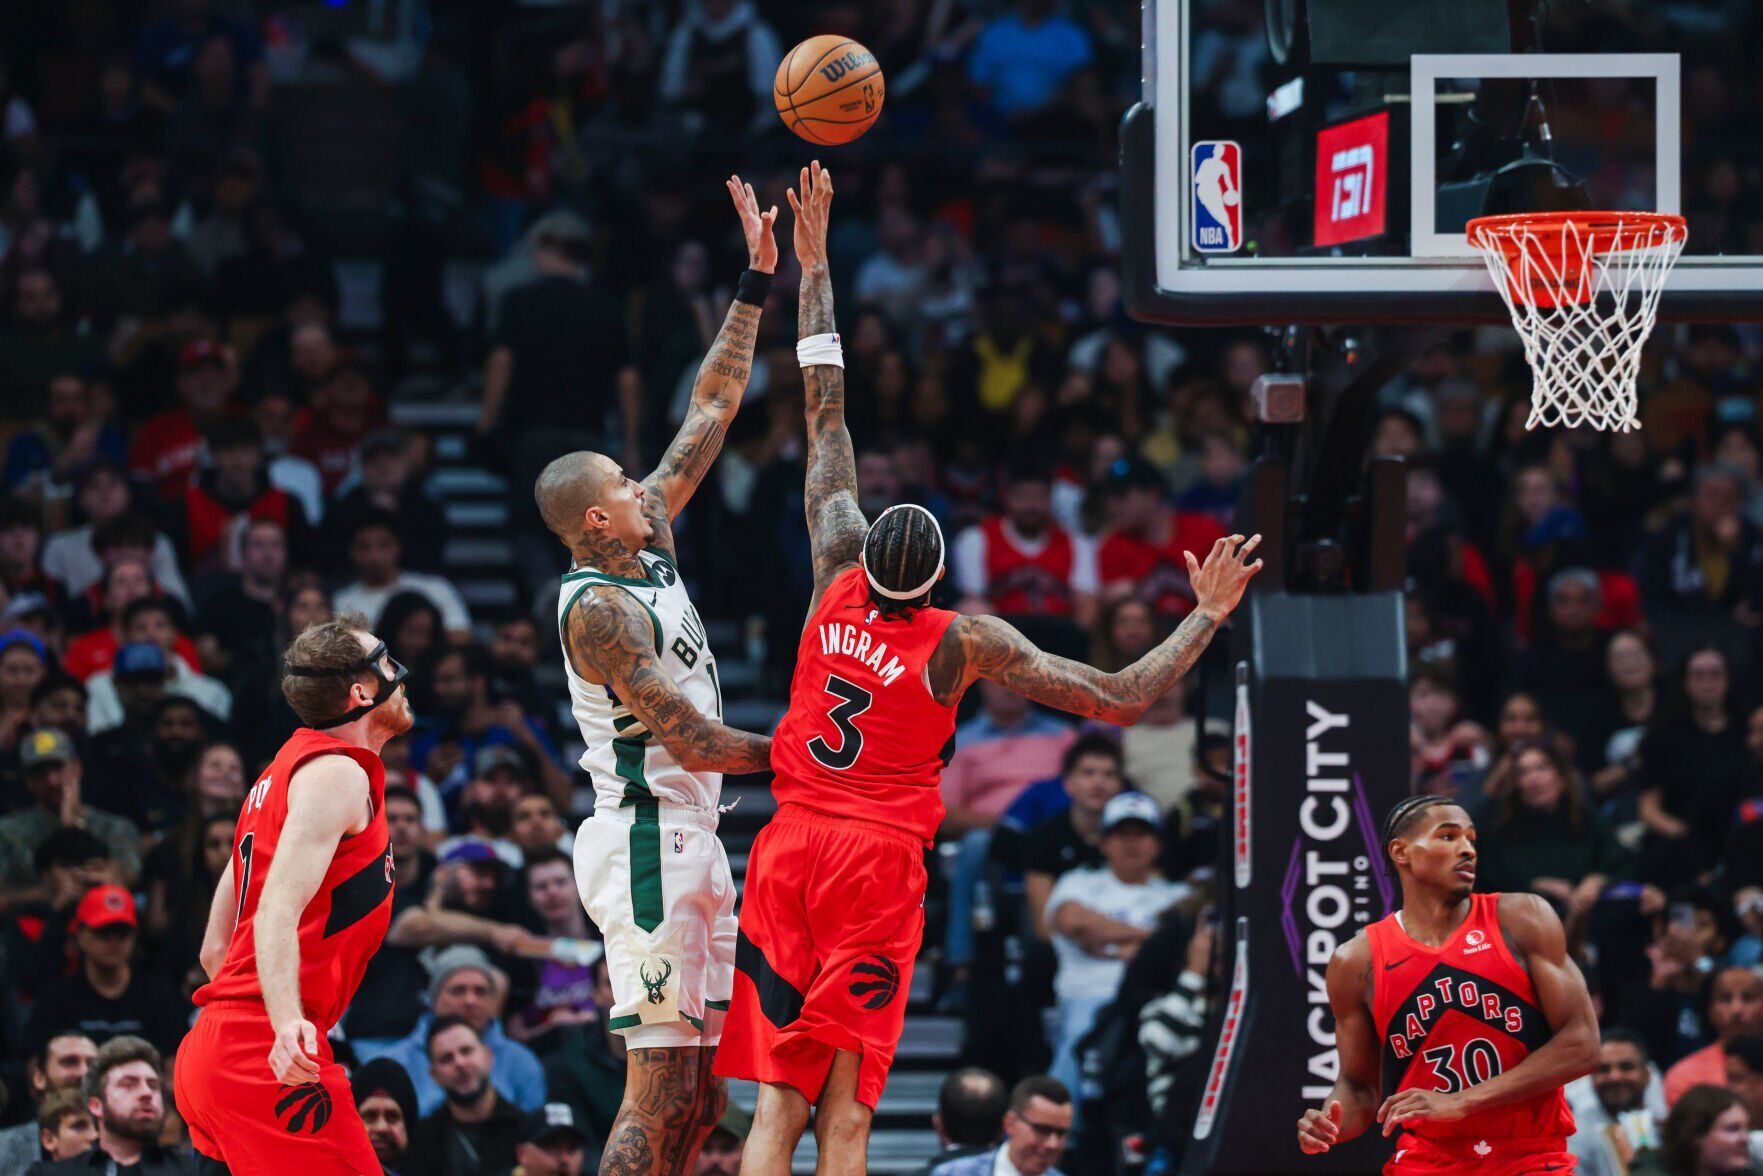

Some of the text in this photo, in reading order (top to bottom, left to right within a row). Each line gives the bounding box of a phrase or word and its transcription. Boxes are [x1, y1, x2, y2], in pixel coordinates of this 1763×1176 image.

[1200, 227, 1223, 244] NBA
[819, 623, 906, 687] INGRAM
[806, 673, 873, 770] 3
[1300, 700, 1350, 841] CITY
[1353, 856, 1370, 928] SINO
[1462, 942, 1492, 955] Sun Life
[1389, 976, 1523, 1059] RAPTORS
[1423, 1037, 1502, 1094] 30
